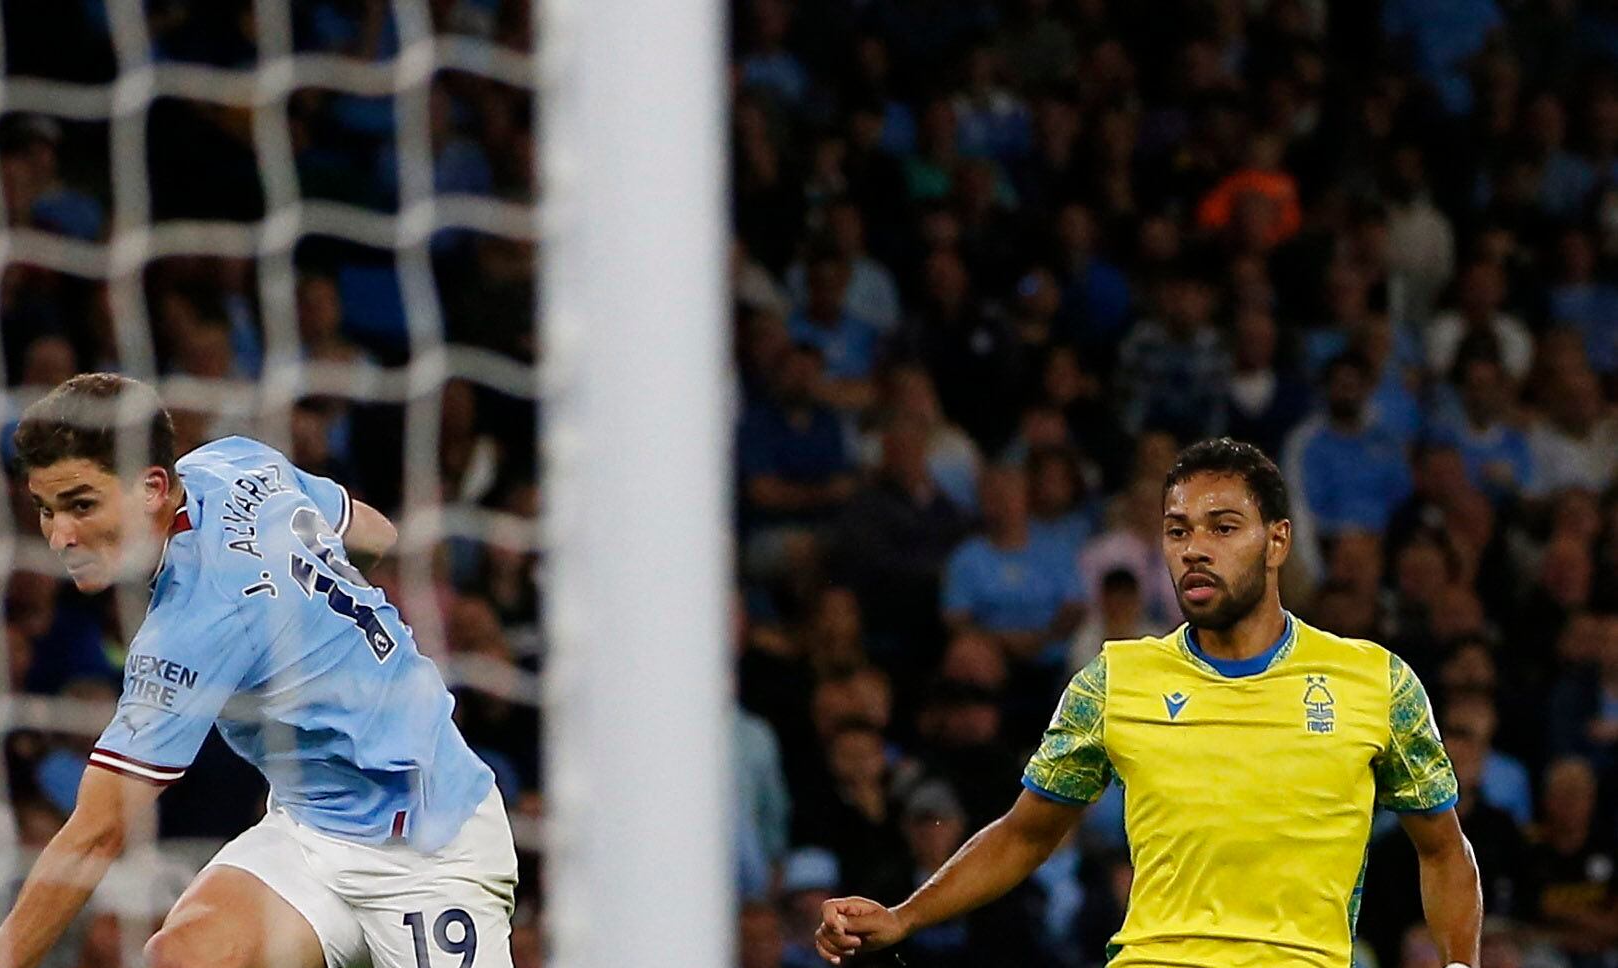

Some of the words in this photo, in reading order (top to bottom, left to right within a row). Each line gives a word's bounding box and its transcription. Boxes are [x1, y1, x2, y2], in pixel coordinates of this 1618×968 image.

[221, 464, 292, 560] ALVAREZ
[243, 570, 277, 598] J.
[127, 654, 199, 690] NEXEN
[128, 676, 178, 708] TIRE
